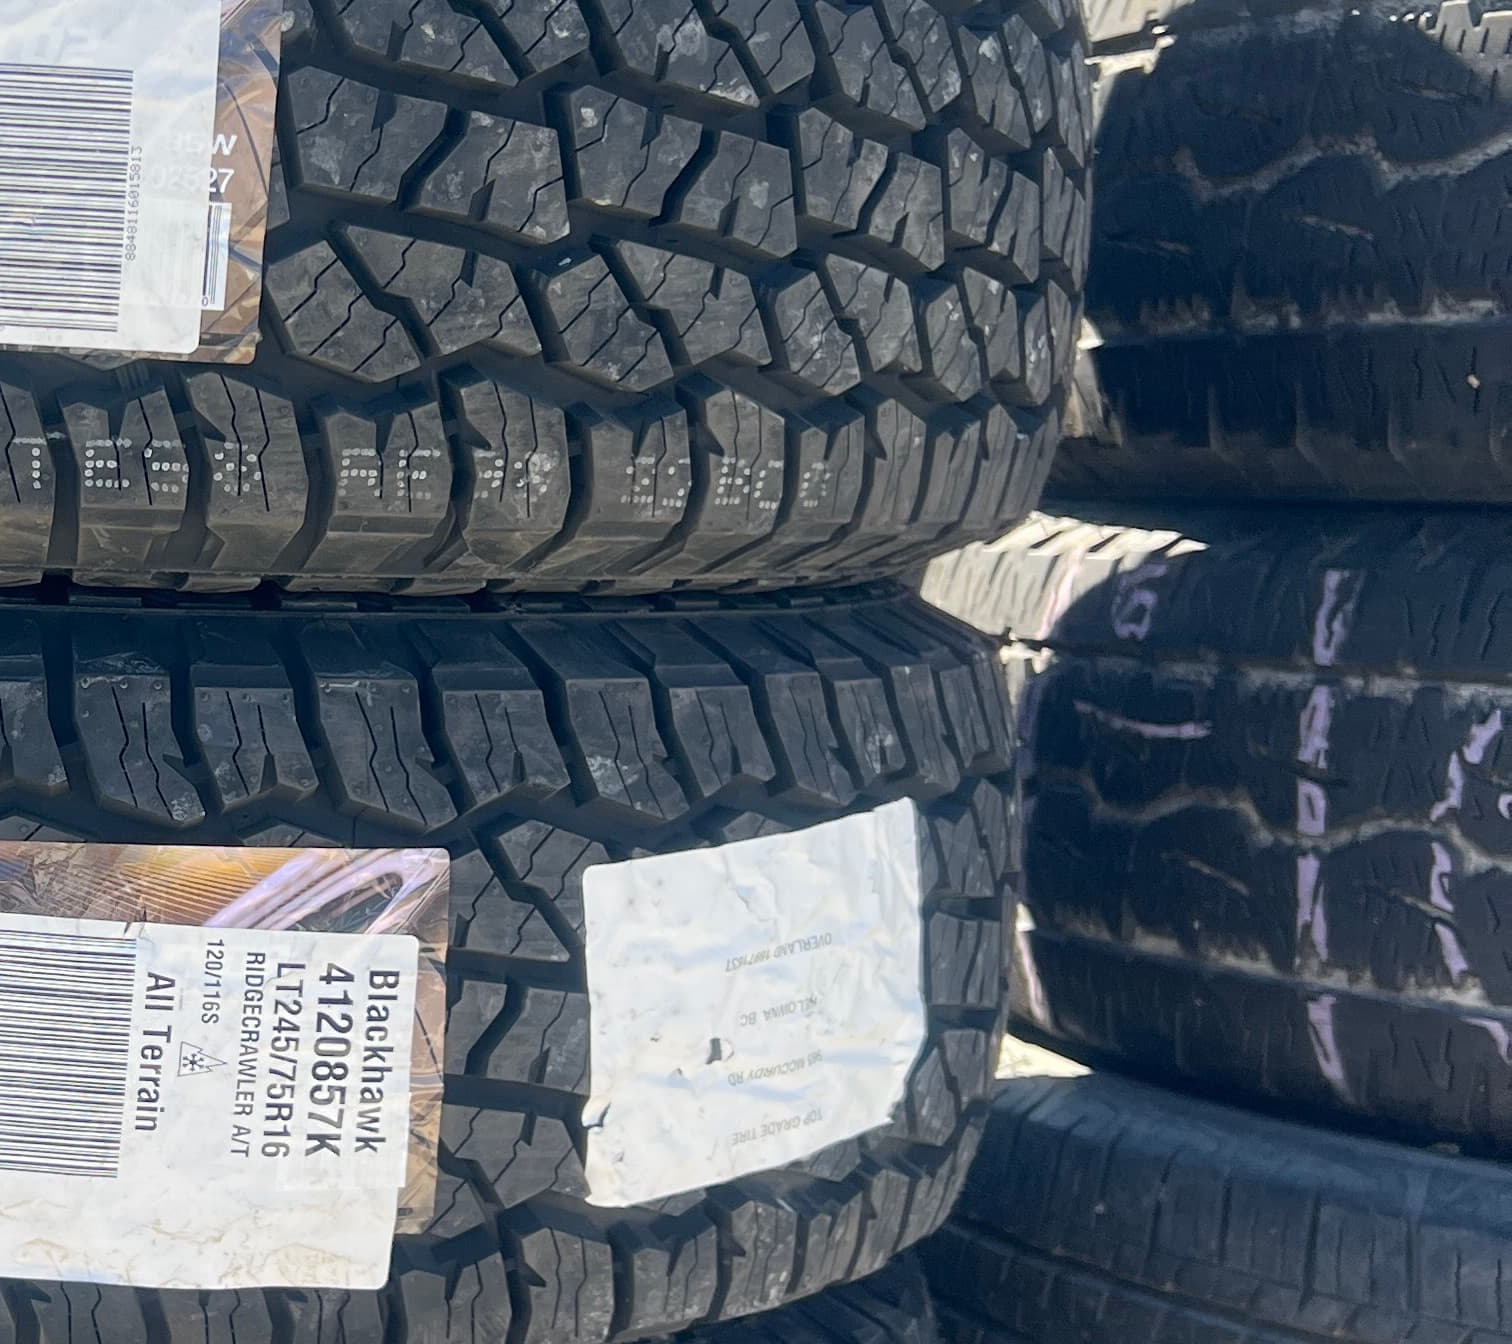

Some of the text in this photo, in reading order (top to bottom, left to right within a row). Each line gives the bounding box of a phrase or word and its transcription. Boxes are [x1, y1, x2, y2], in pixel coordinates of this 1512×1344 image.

[124, 145, 143, 262] 8848116015813
[200, 938, 225, 1025] 120/116S
[773, 932, 832, 958] OVERLAND
[134, 971, 176, 1133] All Terrain
[229, 951, 266, 1159] RIDGECRAWLER A/T
[262, 961, 306, 1159] LT245/75R16
[304, 962, 355, 1157] 4120857K
[354, 969, 400, 1154] Blackhawk
[739, 1011, 757, 1026] BC
[727, 1070, 745, 1087] RD
[731, 1107, 824, 1146] TOP GRADE TIRE
